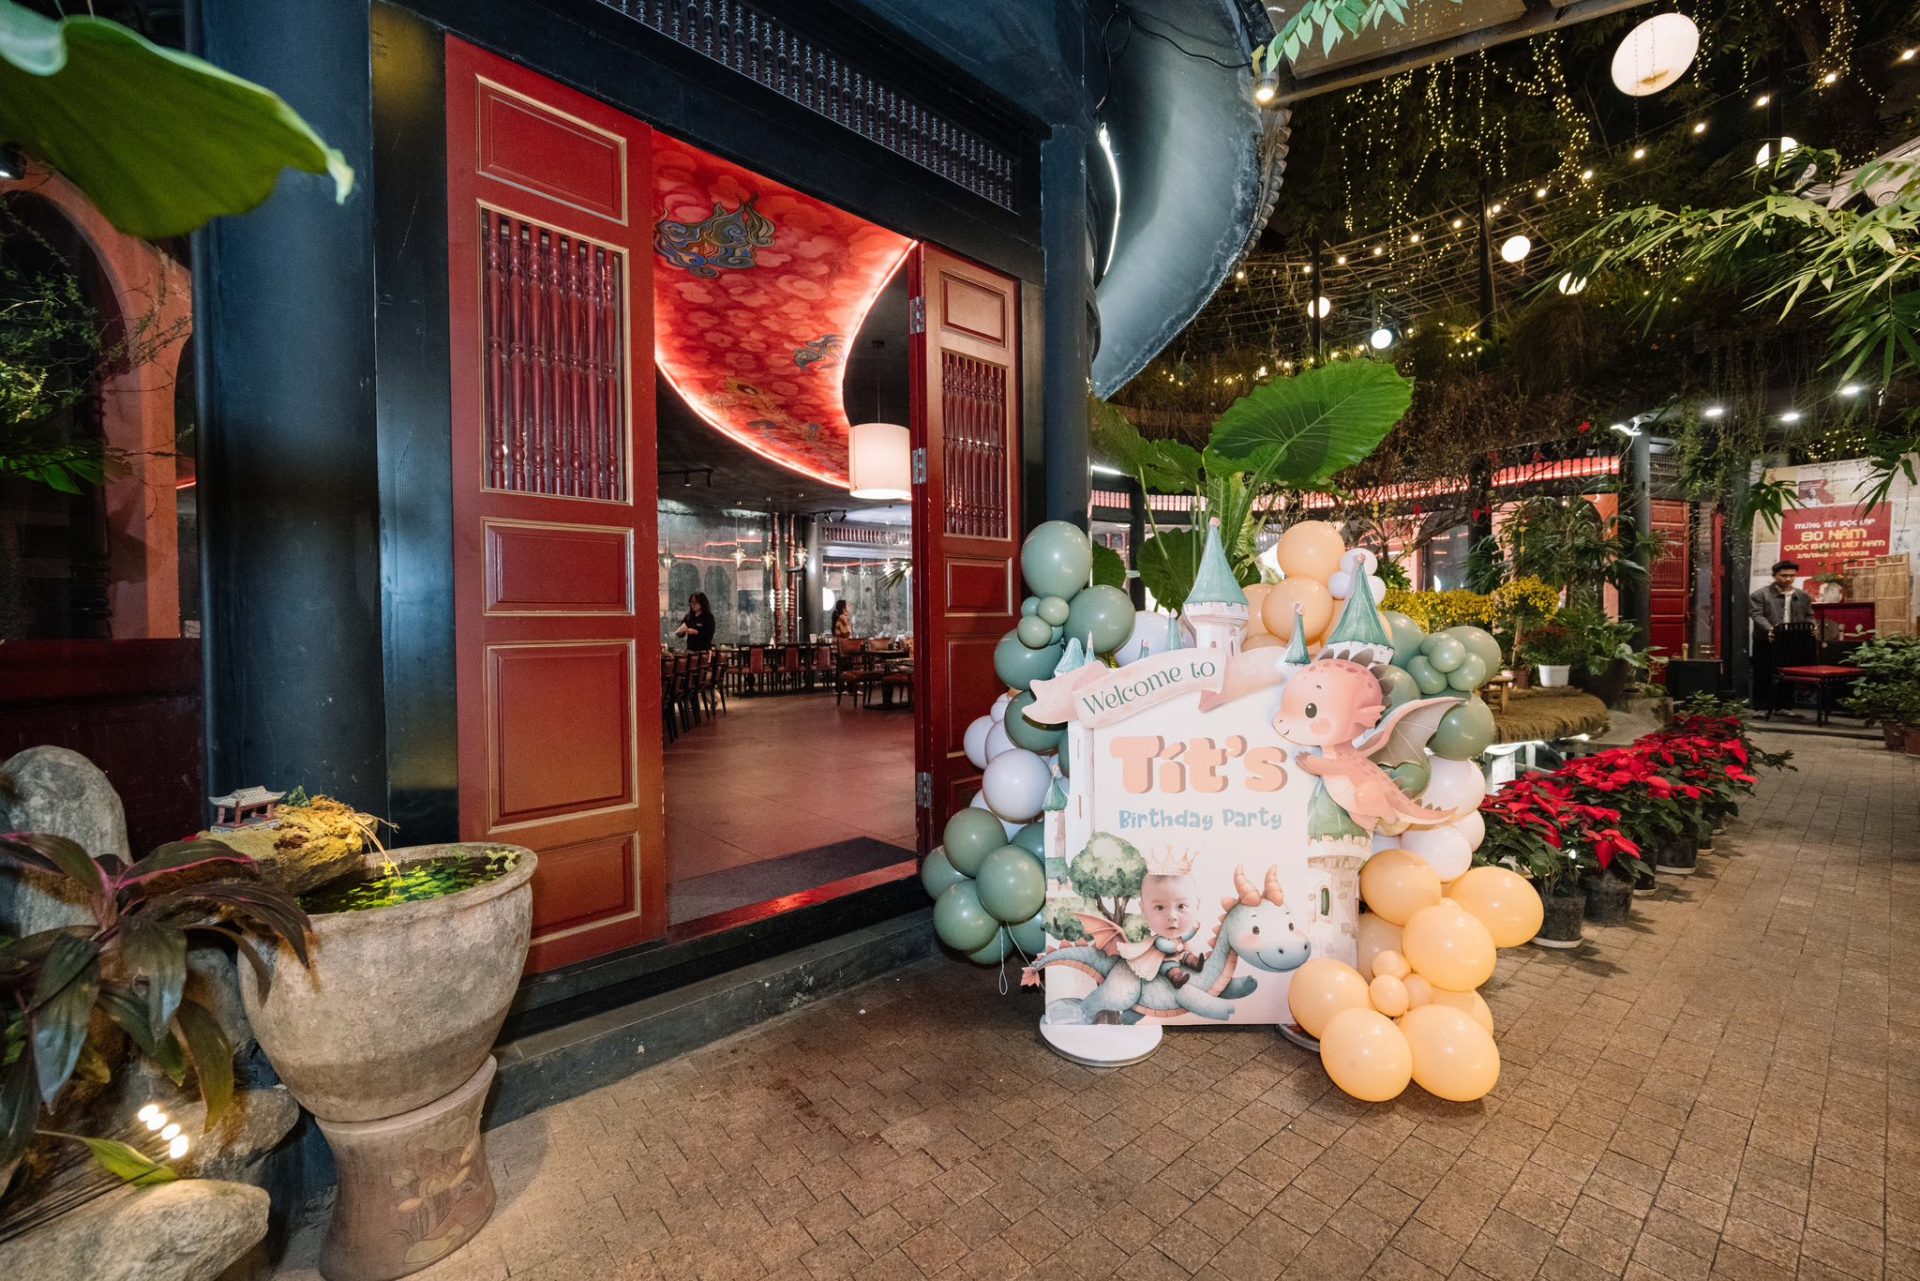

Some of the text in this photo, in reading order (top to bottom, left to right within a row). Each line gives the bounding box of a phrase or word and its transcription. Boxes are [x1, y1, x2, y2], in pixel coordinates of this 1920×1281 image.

[1801, 531, 1824, 542] 80
[1082, 660, 1216, 716] Welcome to
[1118, 806, 1282, 831] Birthday Party
